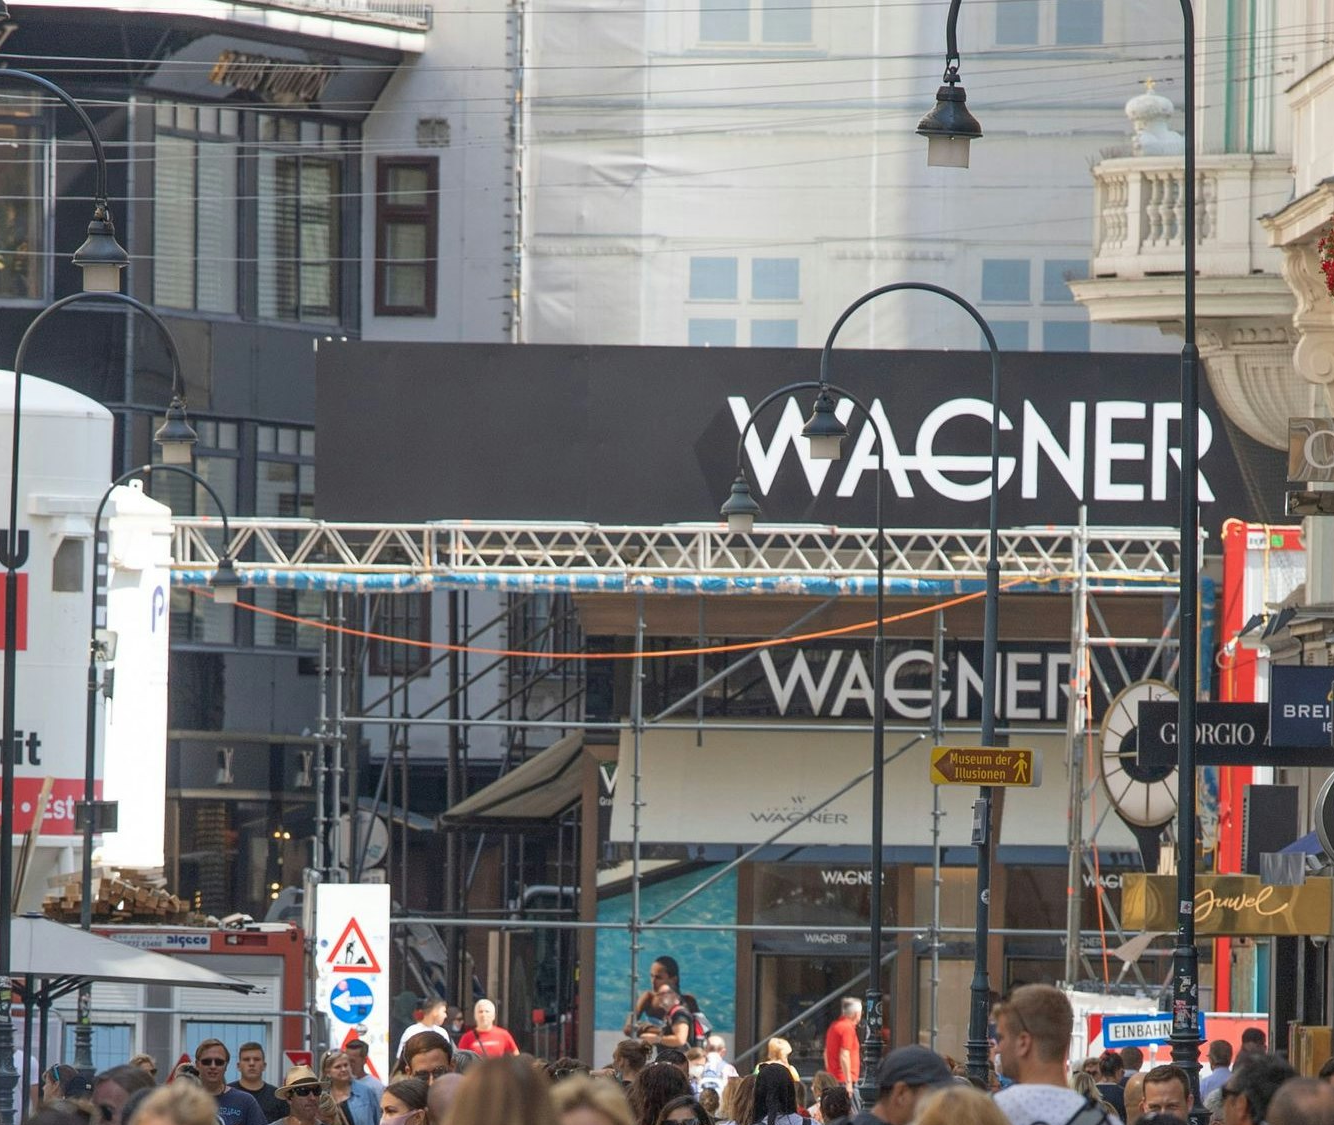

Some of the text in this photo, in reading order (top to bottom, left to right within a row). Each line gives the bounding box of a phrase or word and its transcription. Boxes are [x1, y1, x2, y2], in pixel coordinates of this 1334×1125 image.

[727, 396, 1216, 502] WAGNER
[949, 751, 1012, 766] Museum der
[954, 766, 1007, 781] Illusionen
